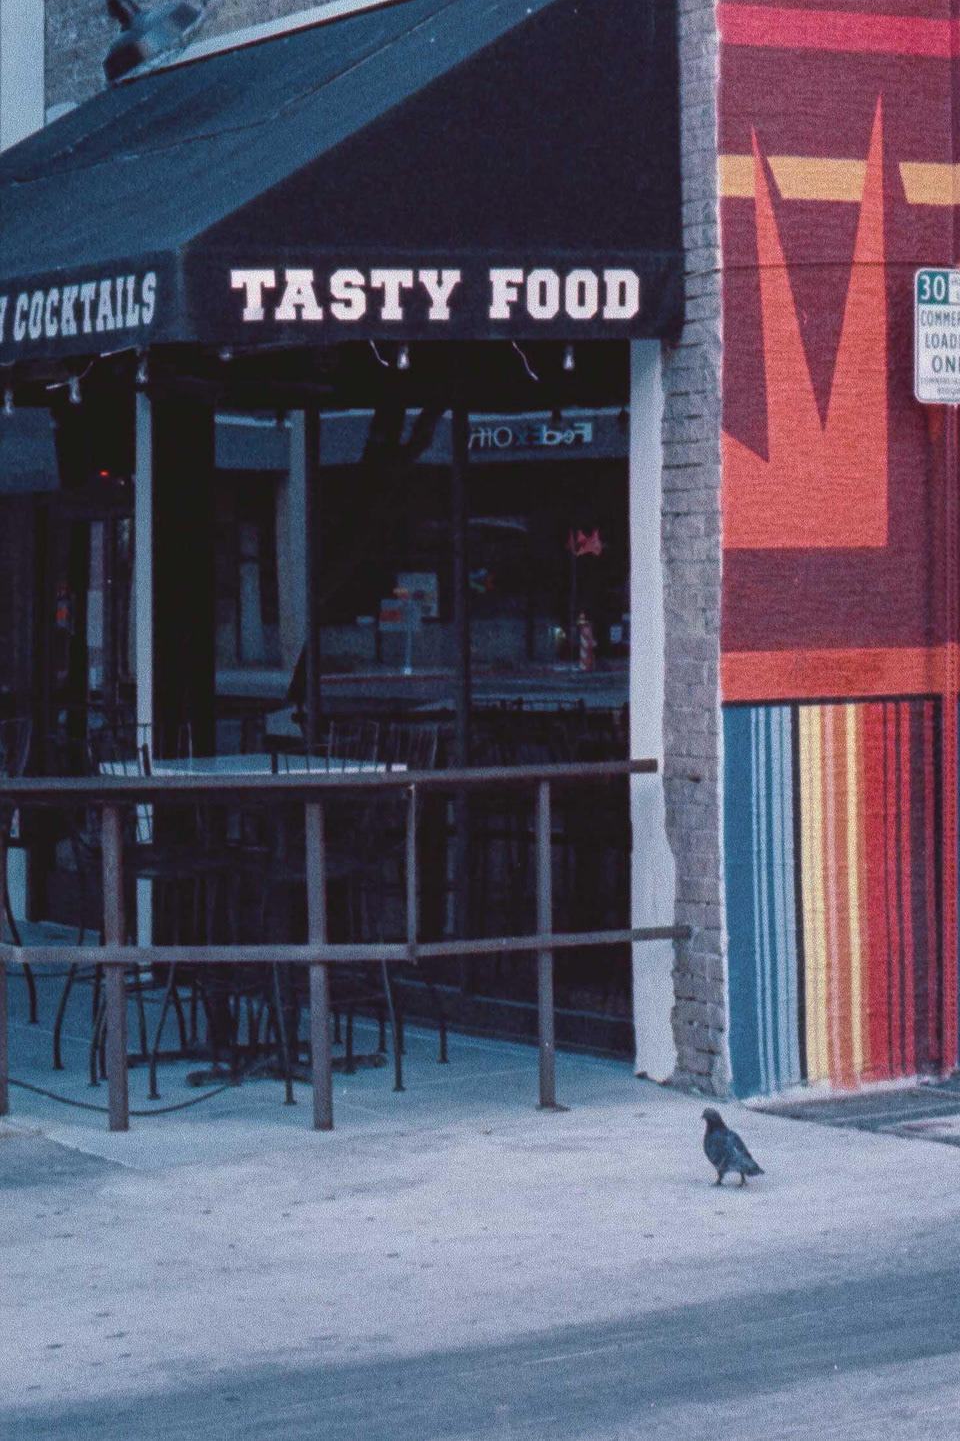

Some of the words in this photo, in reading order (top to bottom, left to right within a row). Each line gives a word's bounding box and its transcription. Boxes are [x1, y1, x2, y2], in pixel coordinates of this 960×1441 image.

[13, 270, 158, 343] COCKTAILS
[229, 268, 462, 322] TASTY
[488, 268, 641, 320] FOOD
[920, 275, 946, 301] 30
